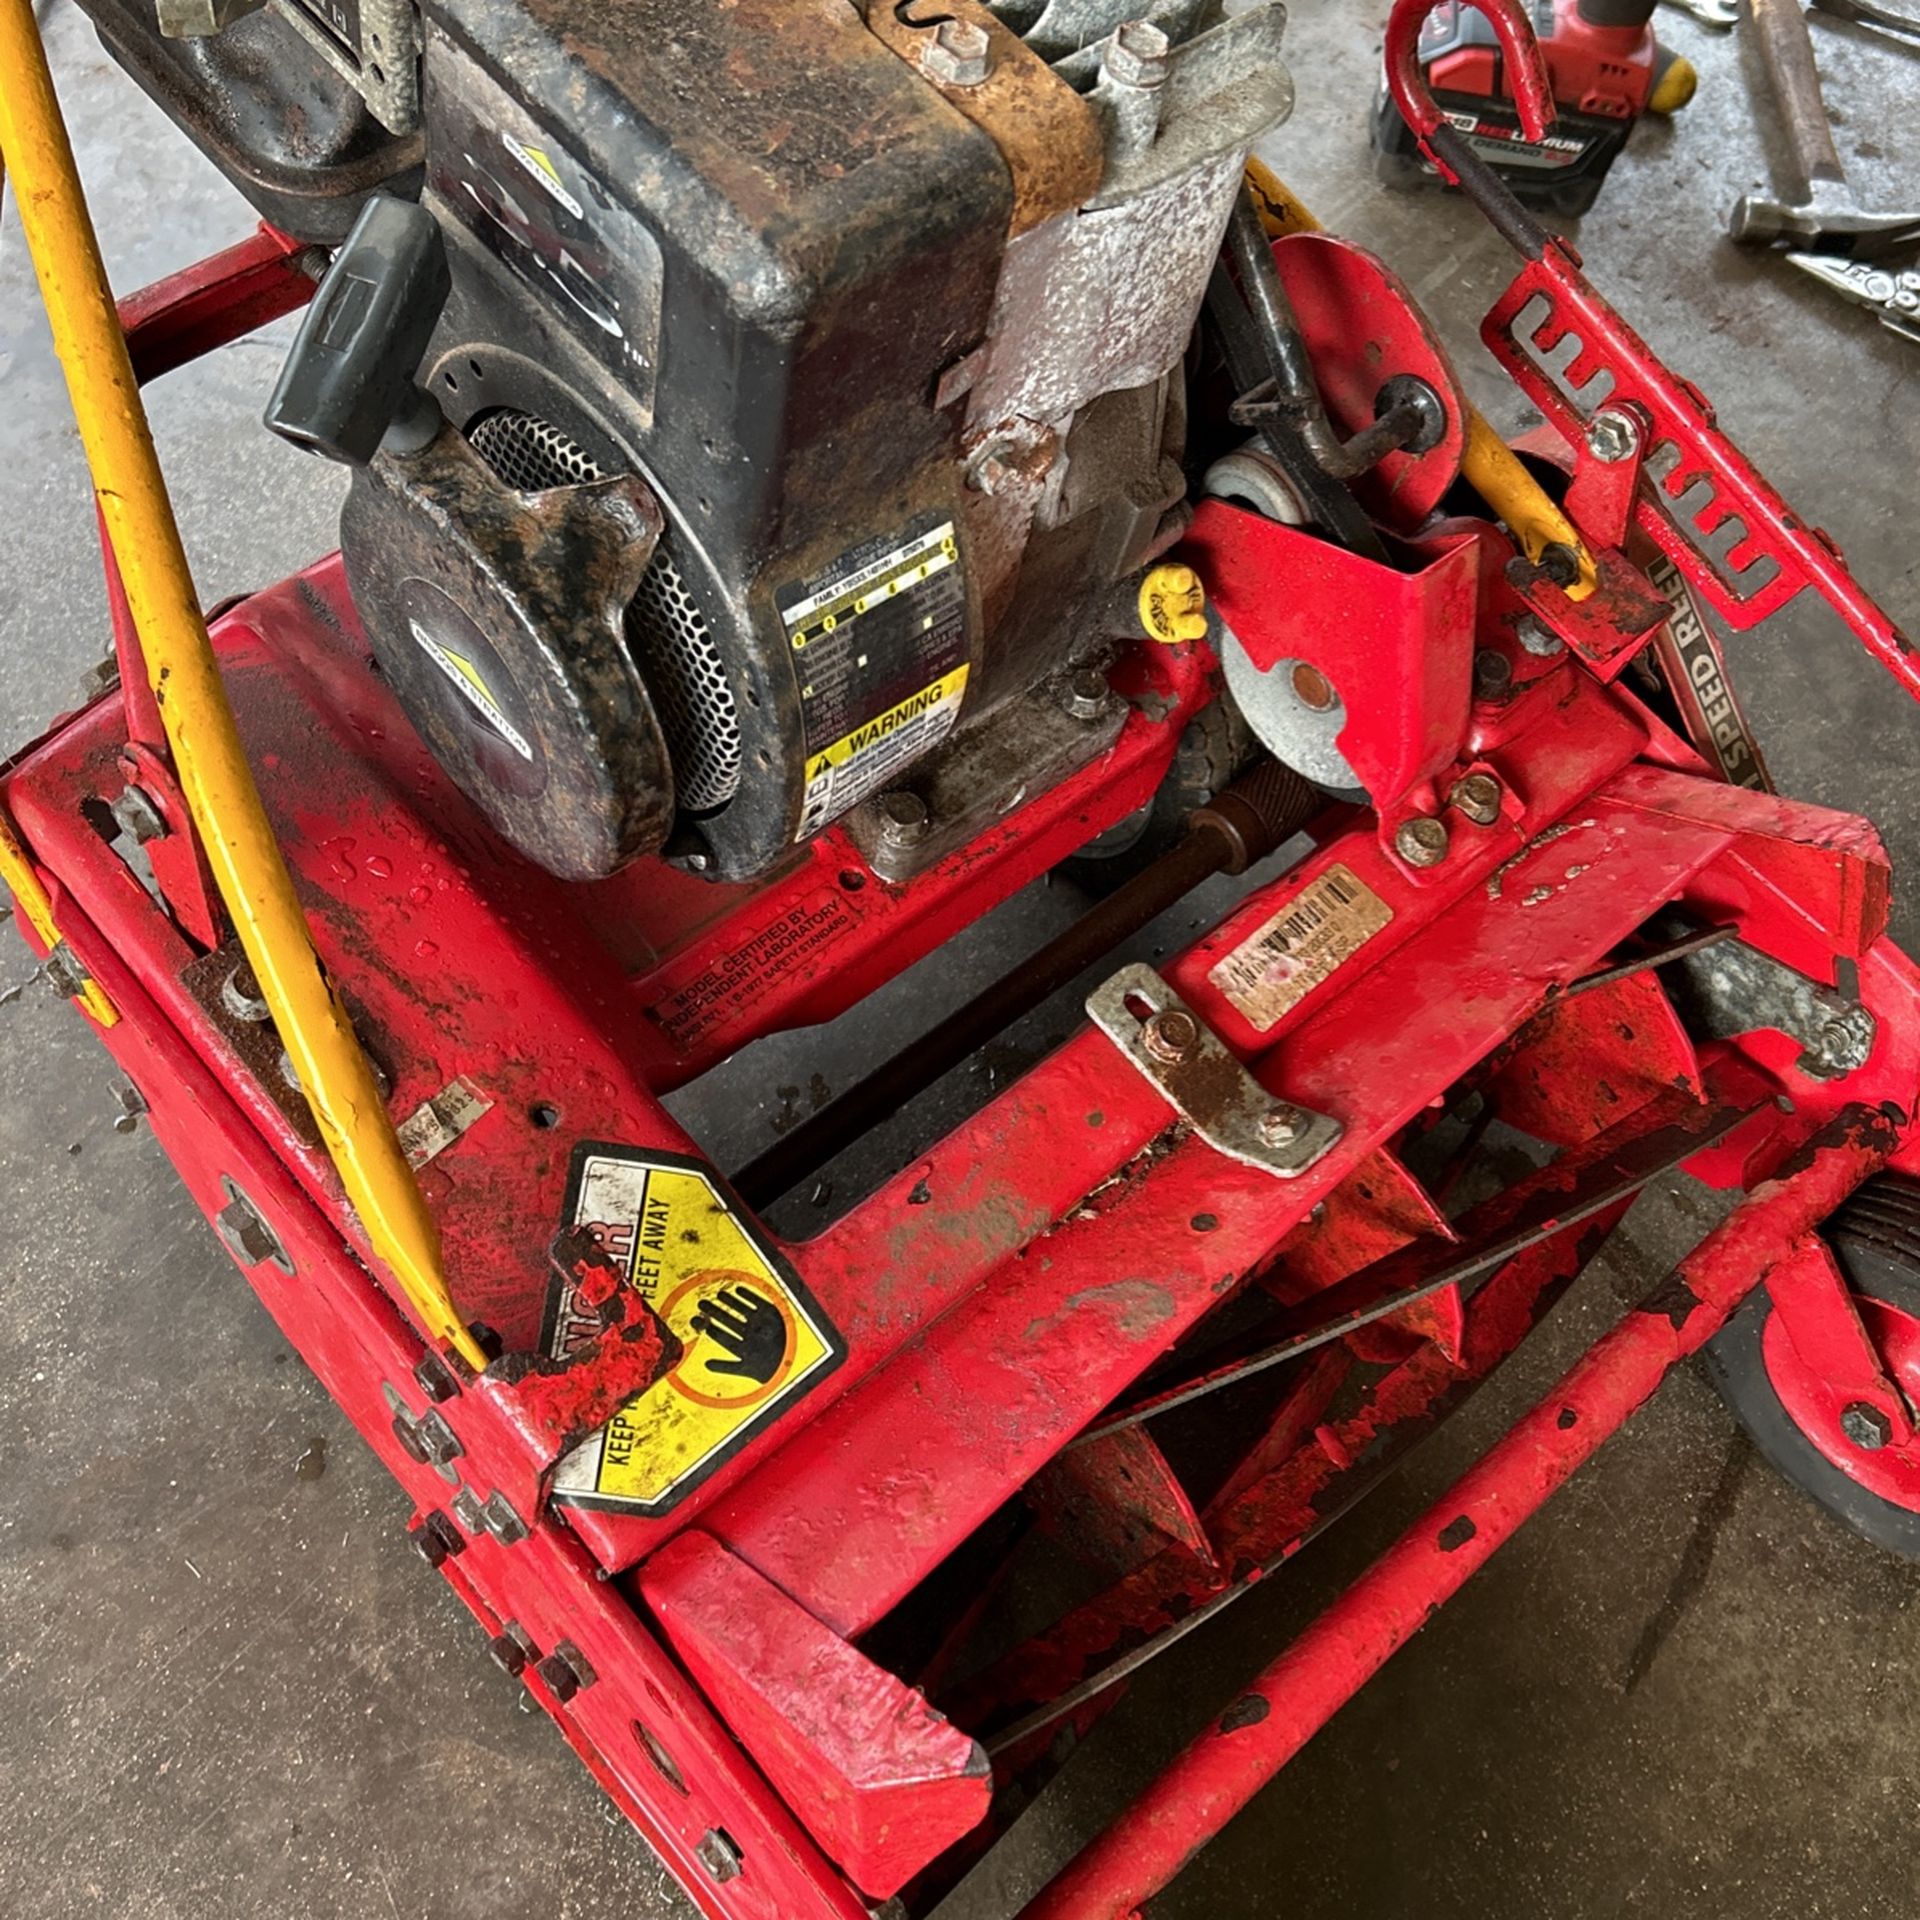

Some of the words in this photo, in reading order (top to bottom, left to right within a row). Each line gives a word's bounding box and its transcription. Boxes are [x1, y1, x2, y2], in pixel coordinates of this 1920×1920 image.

[849, 685, 942, 752] WARNING
[1690, 654, 1749, 769] SPEED
[672, 967, 723, 1009] MODEL
[720, 919, 789, 975] CERTIFIED
[787, 905, 808, 926] BY
[753, 899, 841, 968] LABORATORY
[763, 948, 800, 981] SAFETY
[798, 913, 849, 955] STANDARD
[646, 1197, 671, 1249] AWAY
[637, 1255, 661, 1300] FEET
[606, 1417, 635, 1466] KEEP
